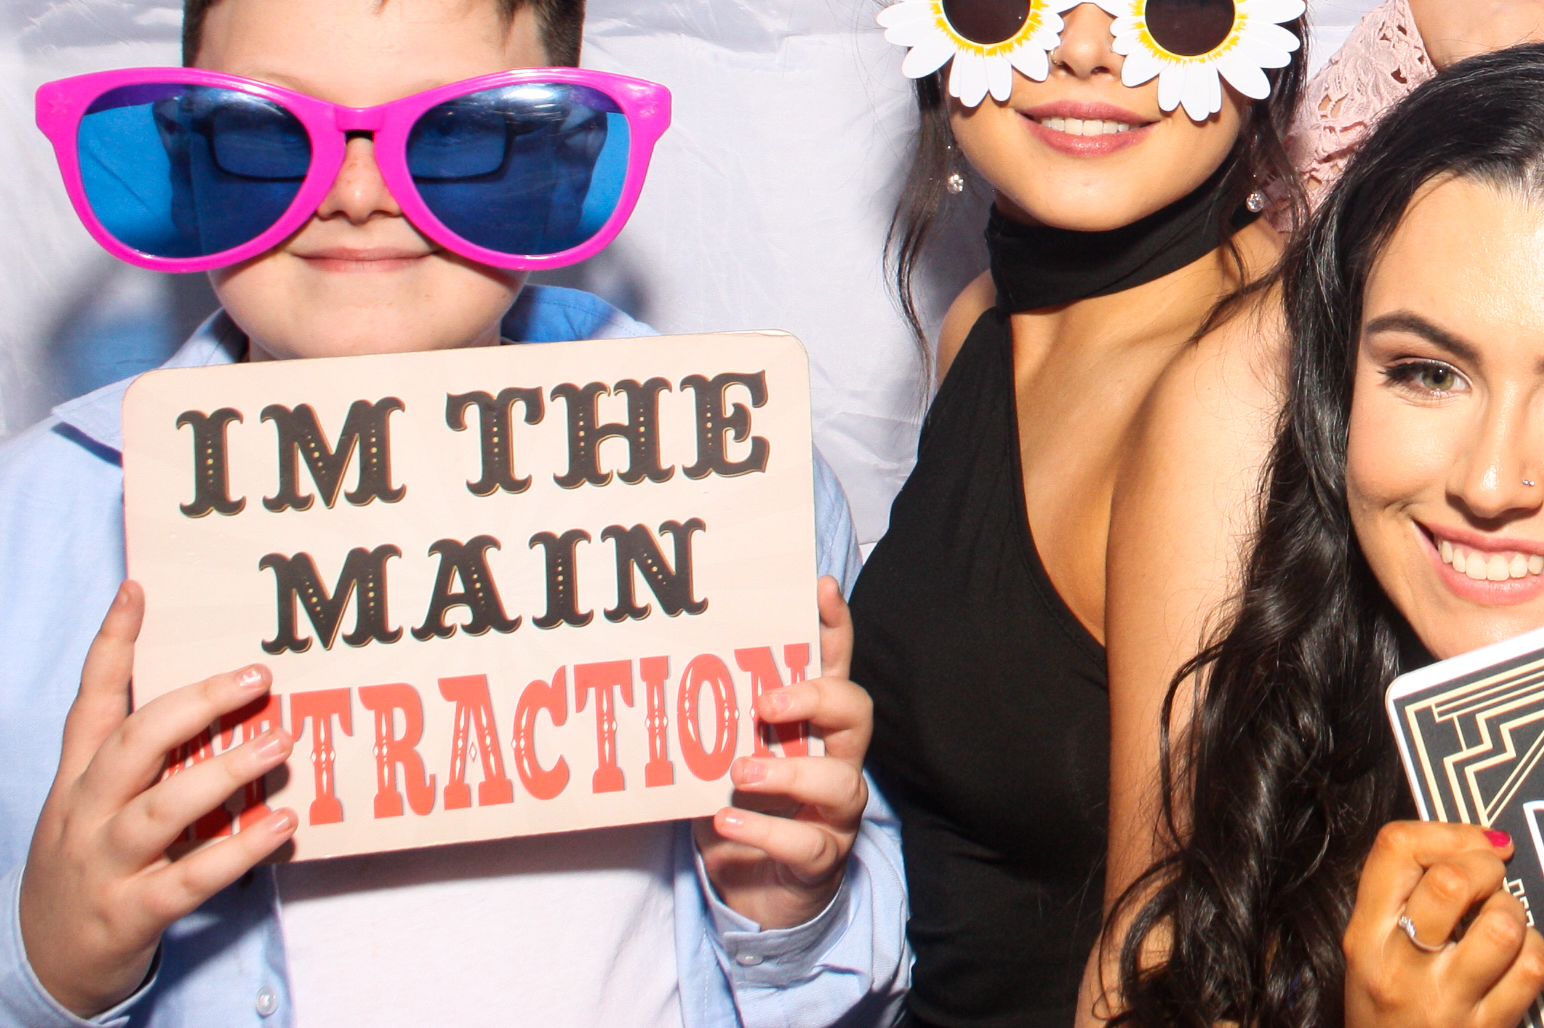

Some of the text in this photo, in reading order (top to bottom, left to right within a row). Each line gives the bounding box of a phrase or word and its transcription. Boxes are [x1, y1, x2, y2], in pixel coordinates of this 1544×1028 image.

[175, 369, 771, 519] IM THE
[257, 517, 709, 655] MAIN
